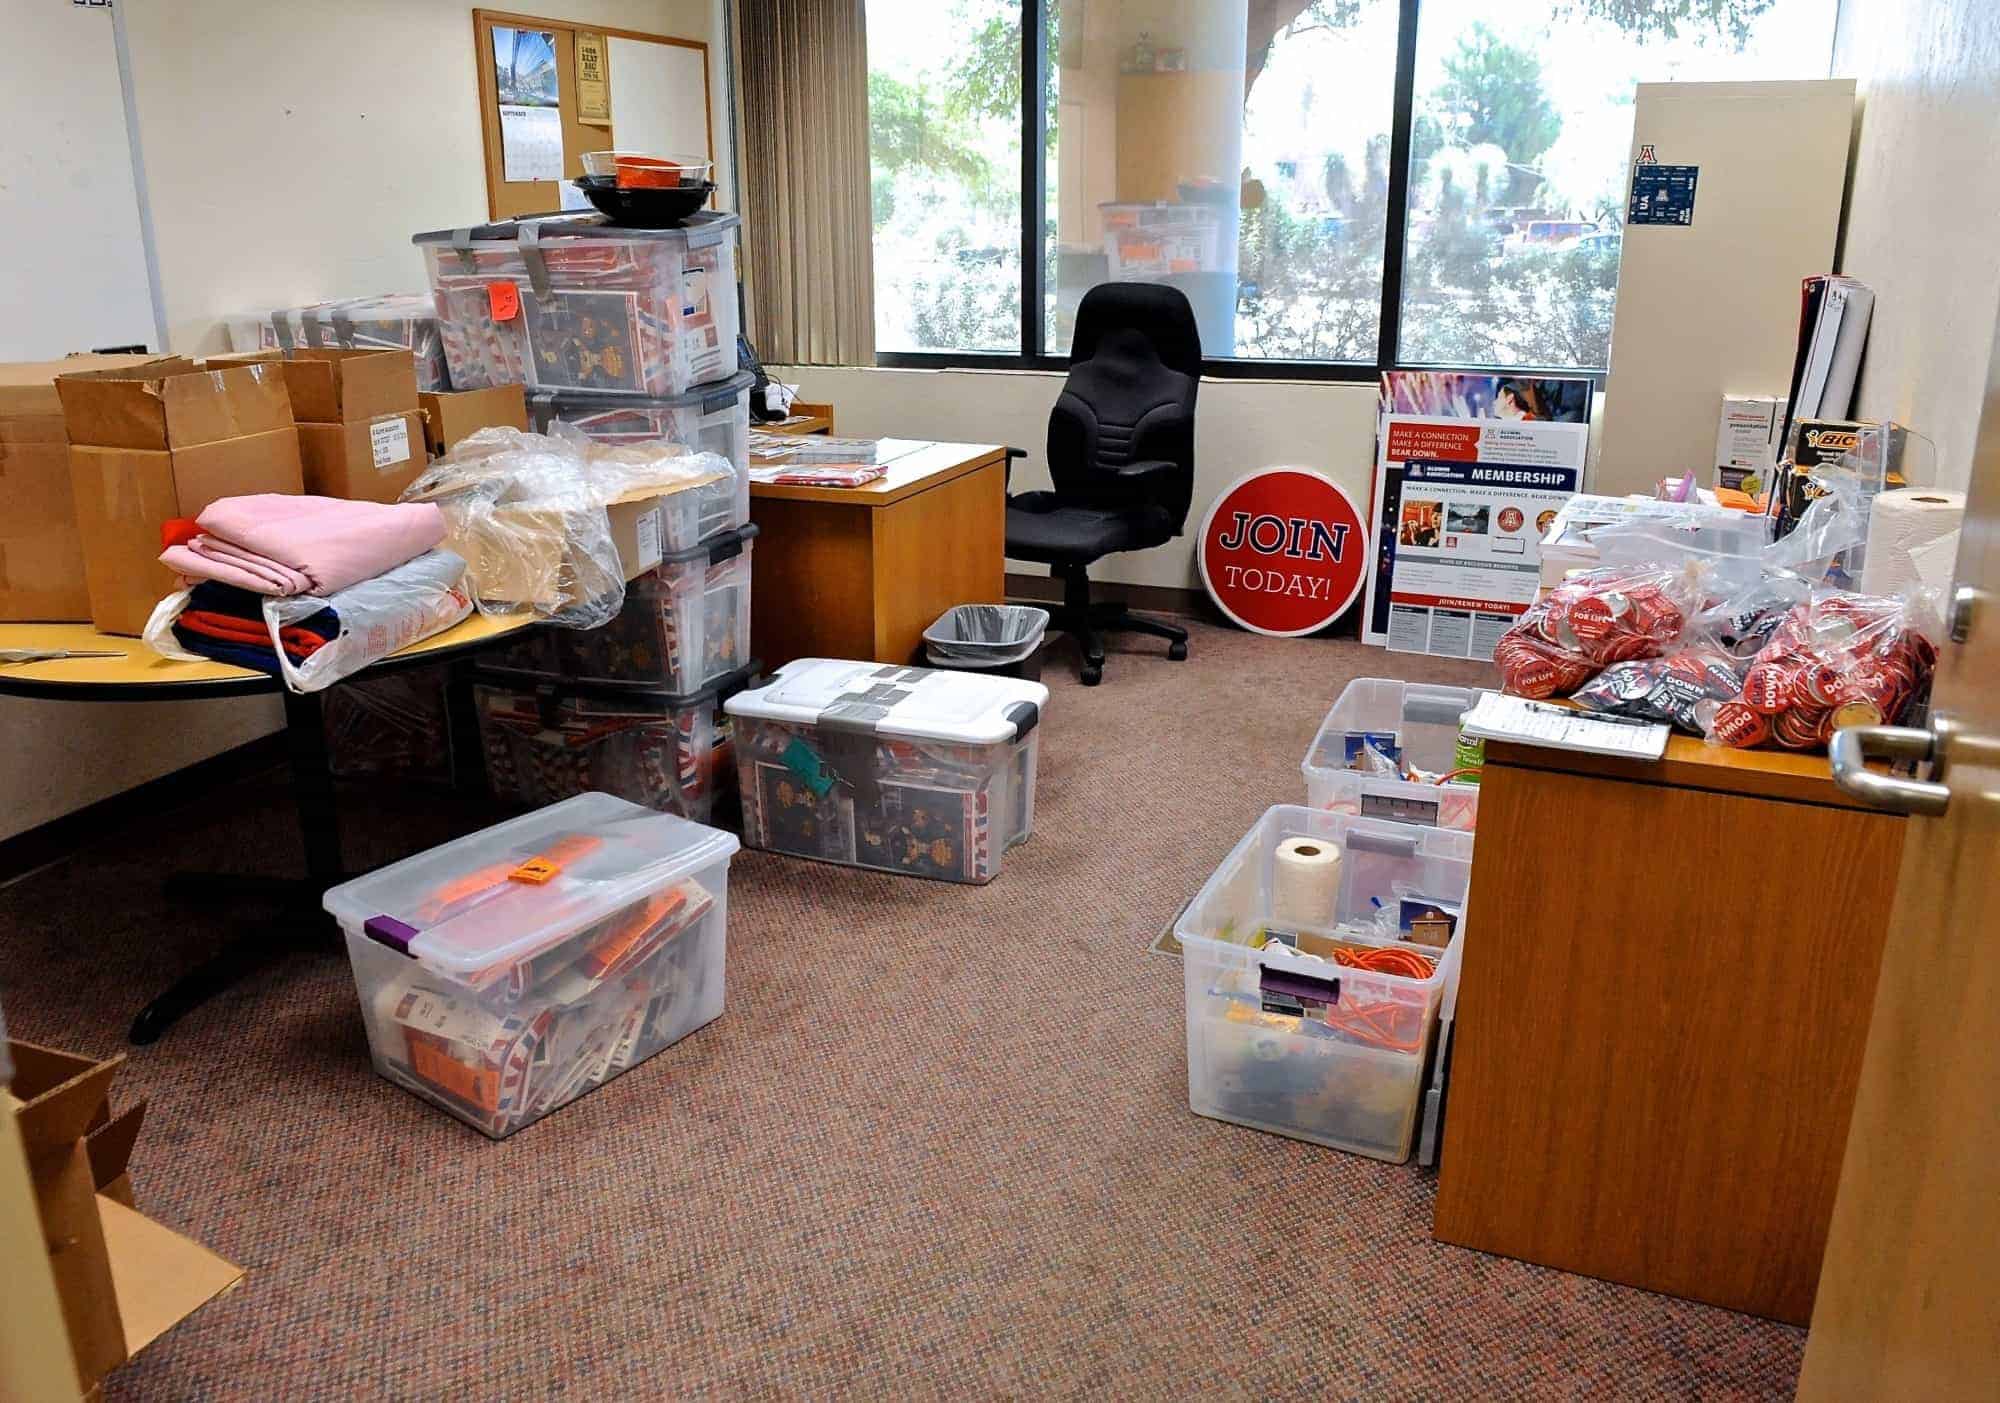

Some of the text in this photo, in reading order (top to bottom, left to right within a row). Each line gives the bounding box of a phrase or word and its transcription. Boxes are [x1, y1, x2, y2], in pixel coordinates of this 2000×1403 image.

[1636, 145, 1657, 164] A
[1392, 430, 1412, 438] MAKE
[1422, 432, 1470, 440] CONNECTION.
[1392, 440, 1412, 448] MAKE
[1421, 441, 1464, 450] DIFFERENCE.
[1472, 469, 1566, 485] MEMBERSHIP
[1219, 512, 1351, 564] JOIN
[1225, 565, 1331, 601] TODAY!
[1438, 598, 1510, 611] JOIN/RENEW TODAY!
[1574, 612, 1589, 620] FOR
[1521, 672, 1554, 686] FOR LIFE
[1666, 676, 1705, 694] DOWN
[1708, 666, 1742, 693] DOWN
[1764, 670, 1777, 708] DOWN
[1718, 712, 1752, 740] DOWN
